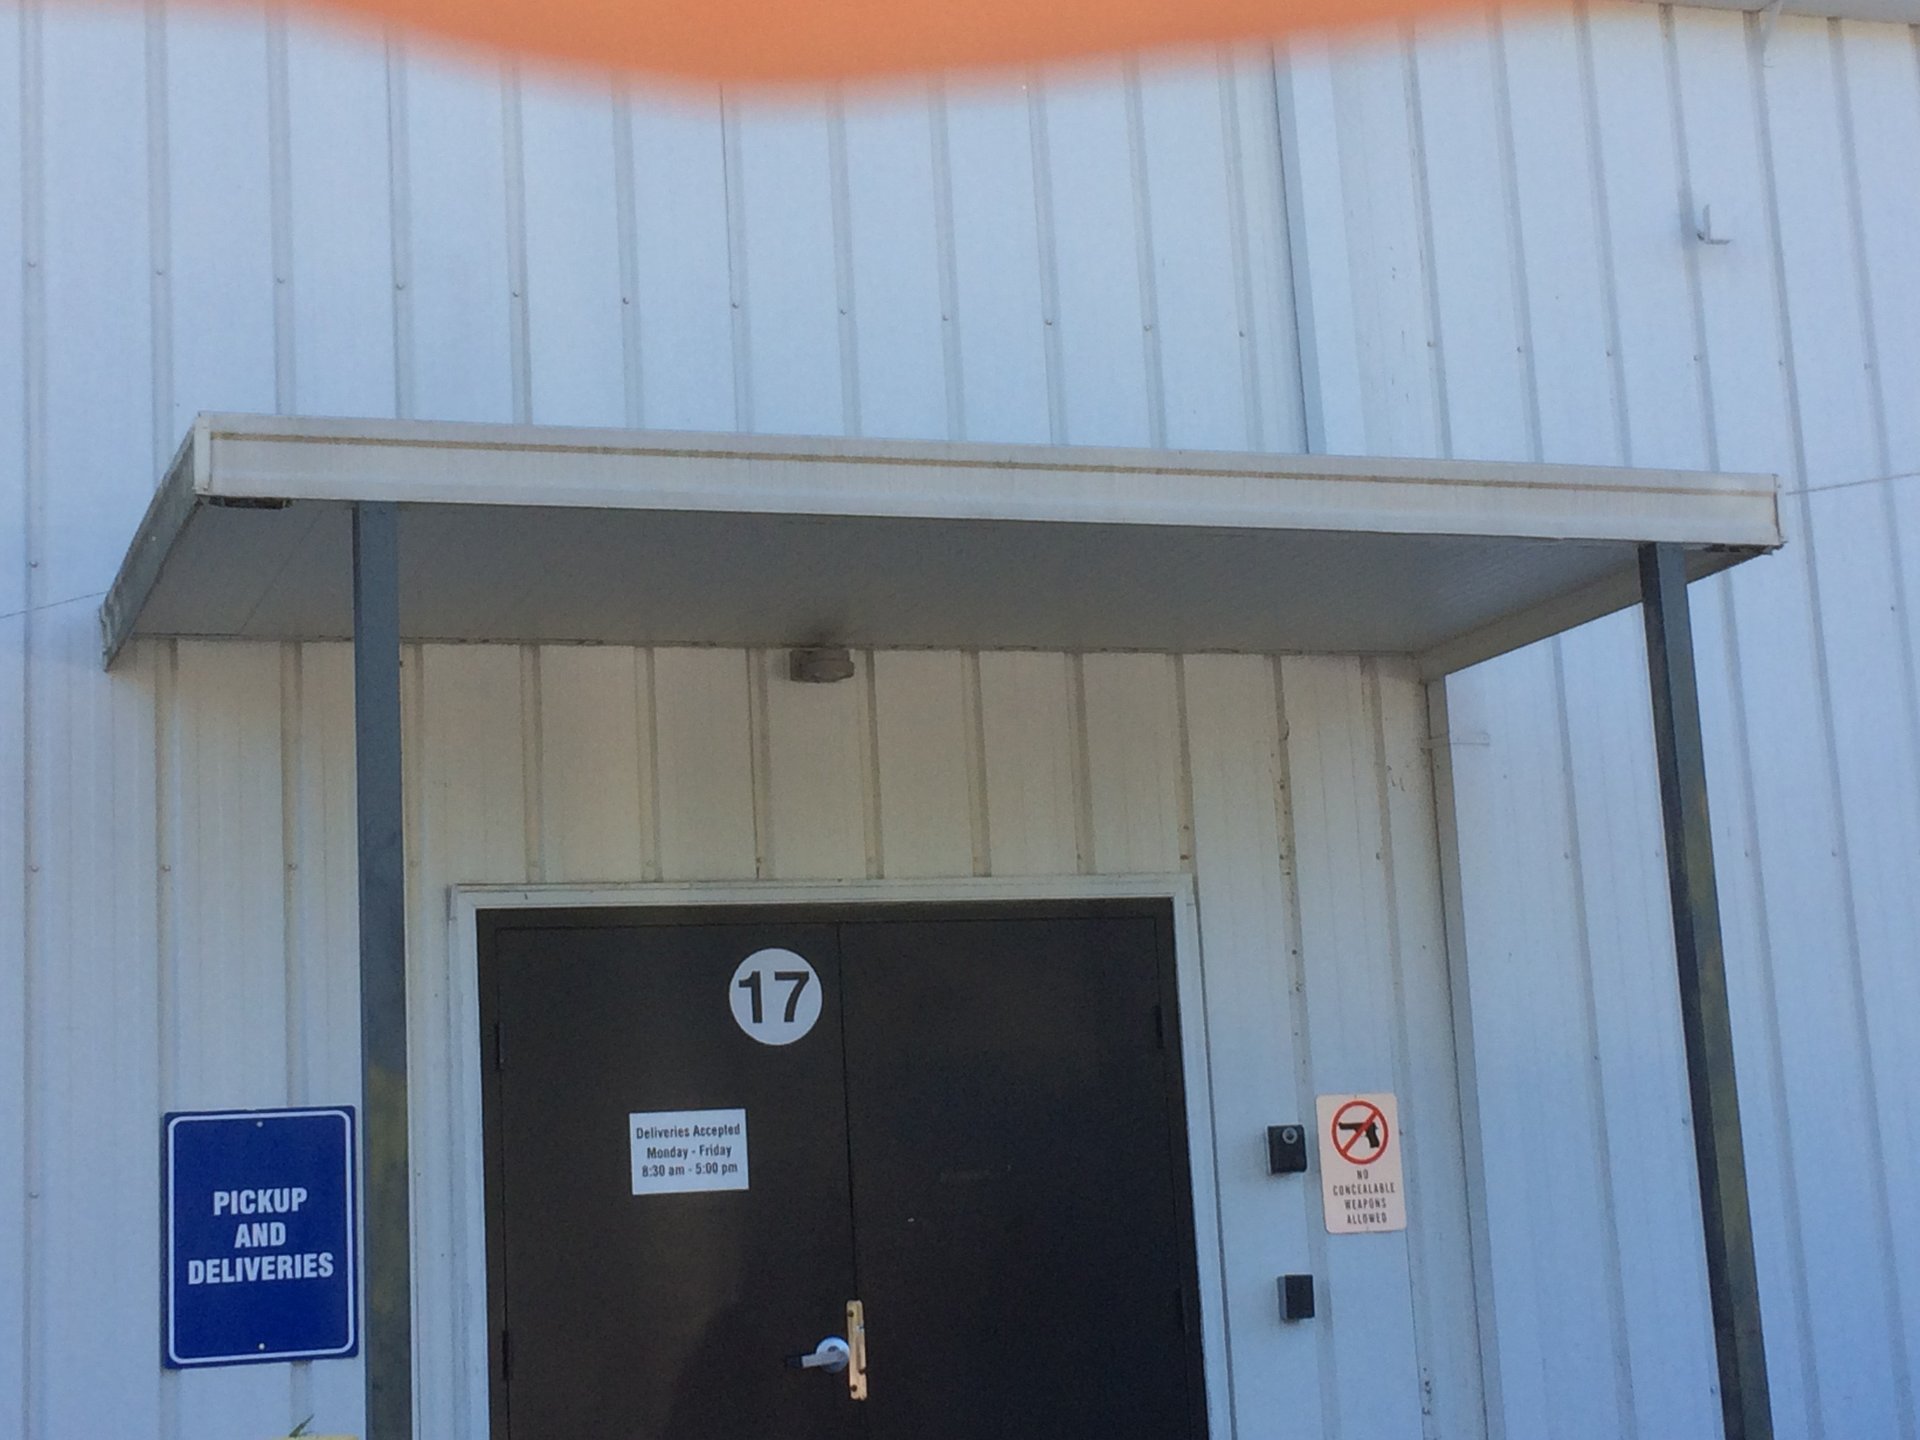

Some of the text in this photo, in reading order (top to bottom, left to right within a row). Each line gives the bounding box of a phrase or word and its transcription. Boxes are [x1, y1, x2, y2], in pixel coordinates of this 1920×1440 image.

[738, 970, 811, 1024] 17
[636, 1123, 741, 1140] Deliveries Accepted
[646, 1146, 688, 1160] Monday
[699, 1144, 732, 1158] Friday
[641, 1164, 665, 1178] 8:30
[668, 1166, 685, 1176] am
[695, 1162, 718, 1175] 5:00
[721, 1163, 738, 1176] pm
[1356, 1169, 1369, 1180] NO
[1332, 1182, 1395, 1196] CONCEALABLE
[213, 1187, 308, 1216] PICKUP
[1344, 1197, 1387, 1210] WEAPONS
[1346, 1212, 1387, 1225] ALLOWED
[234, 1222, 287, 1249] AND
[187, 1252, 334, 1285] DELIVERIES
